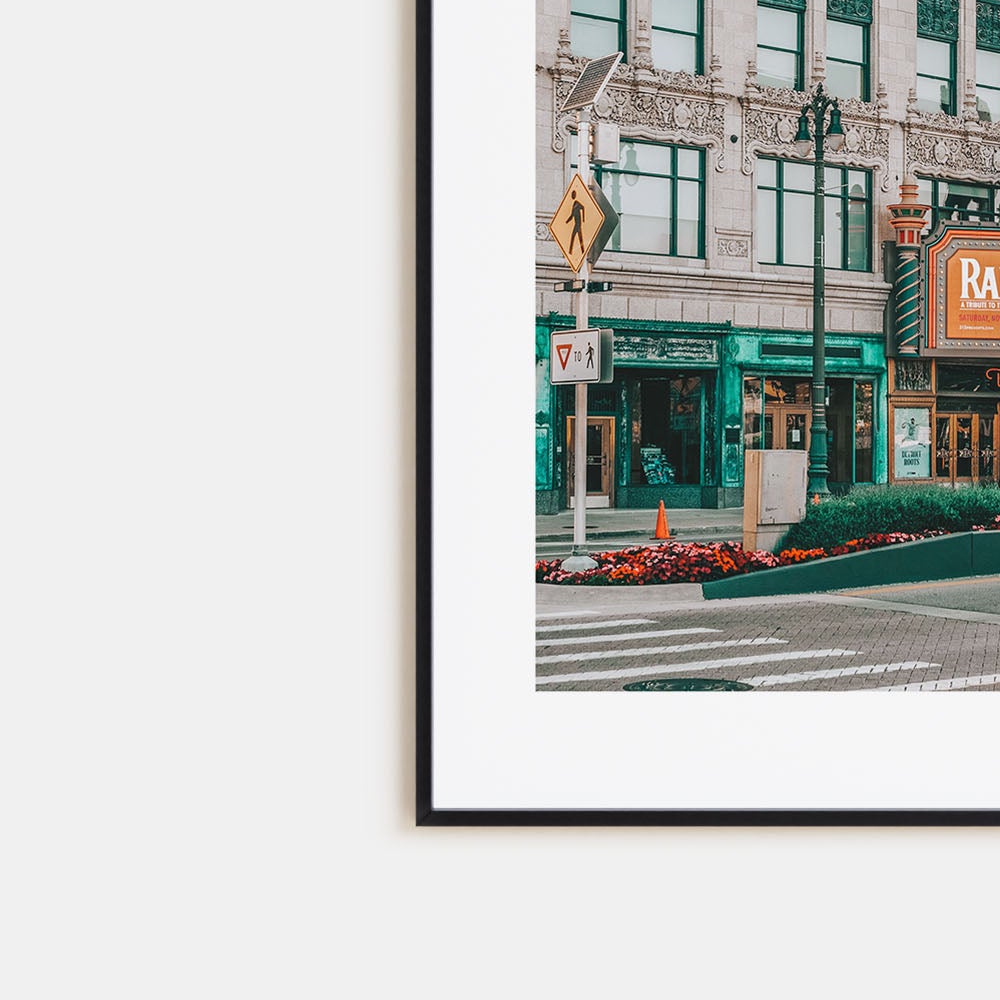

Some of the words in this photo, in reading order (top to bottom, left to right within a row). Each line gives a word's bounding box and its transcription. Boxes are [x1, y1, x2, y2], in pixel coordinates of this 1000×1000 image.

[960, 301, 966, 309] A
[966, 301, 987, 309] TRIBUTE
[574, 350, 582, 362] TO
